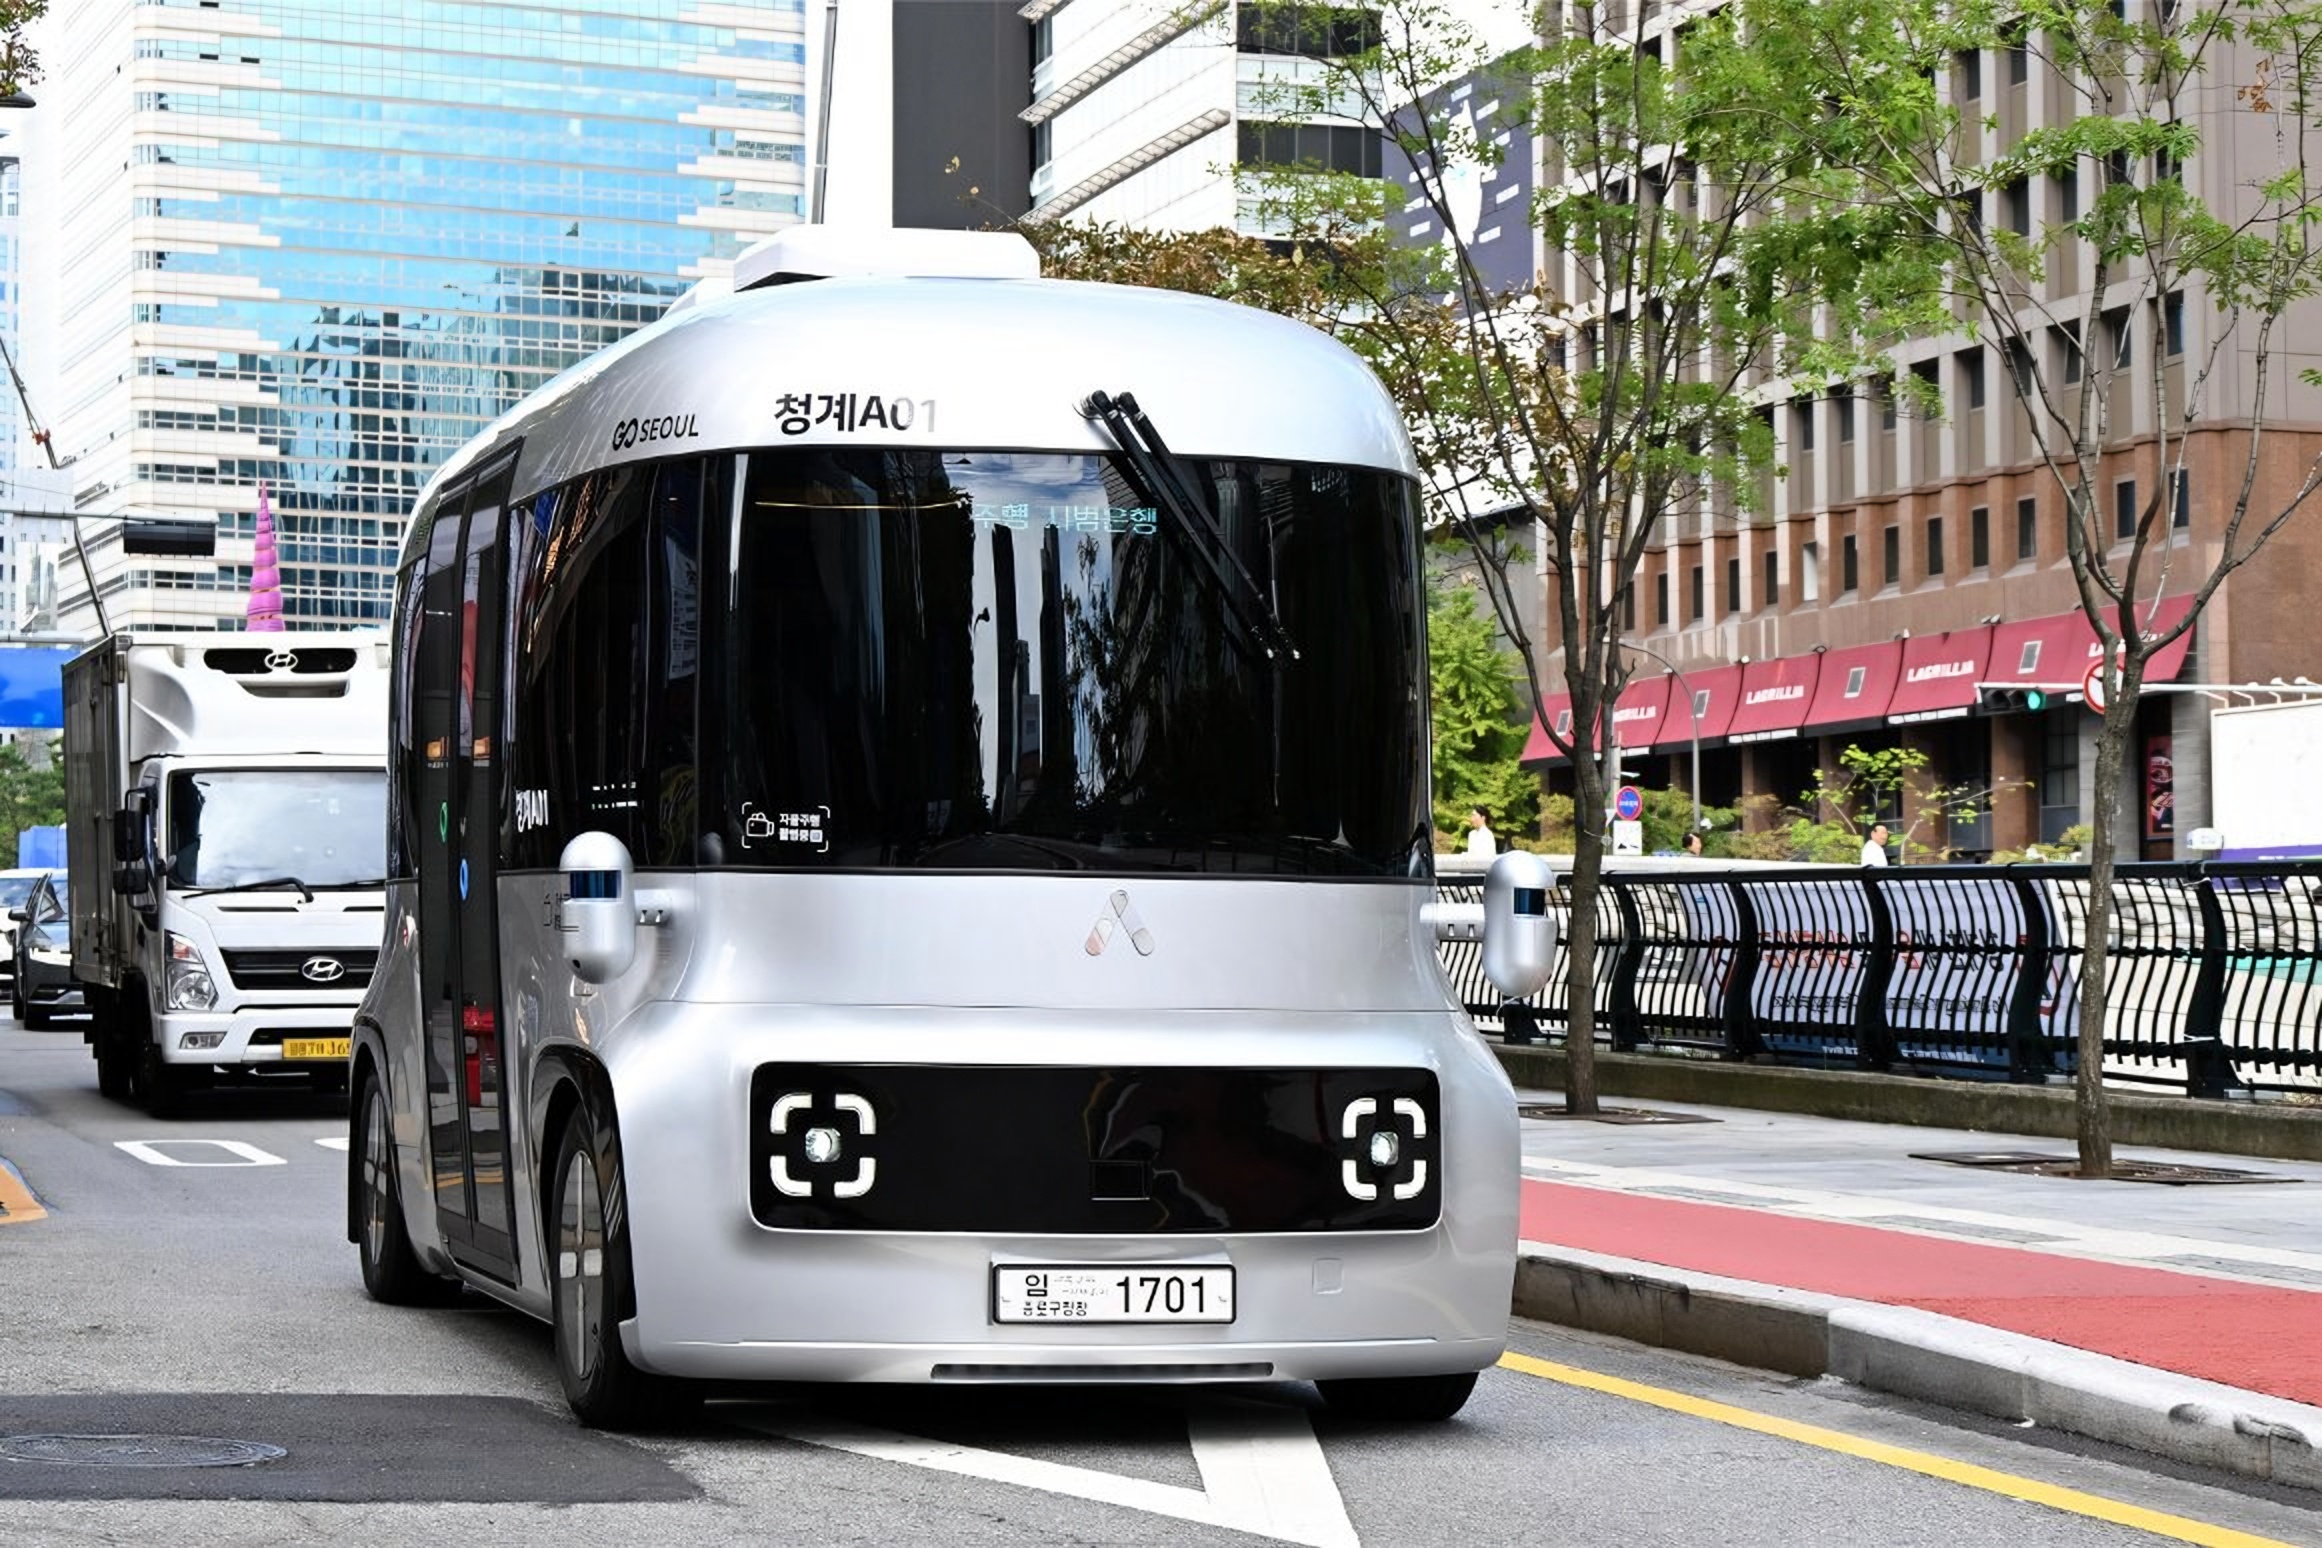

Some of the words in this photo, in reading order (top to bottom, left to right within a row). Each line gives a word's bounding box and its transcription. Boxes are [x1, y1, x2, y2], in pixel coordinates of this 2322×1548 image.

[639, 413, 699, 442] SEOUL
[774, 393, 936, 436] 청계A01
[1025, 1273, 1049, 1298] 임
[1116, 1275, 1205, 1314] 1701
